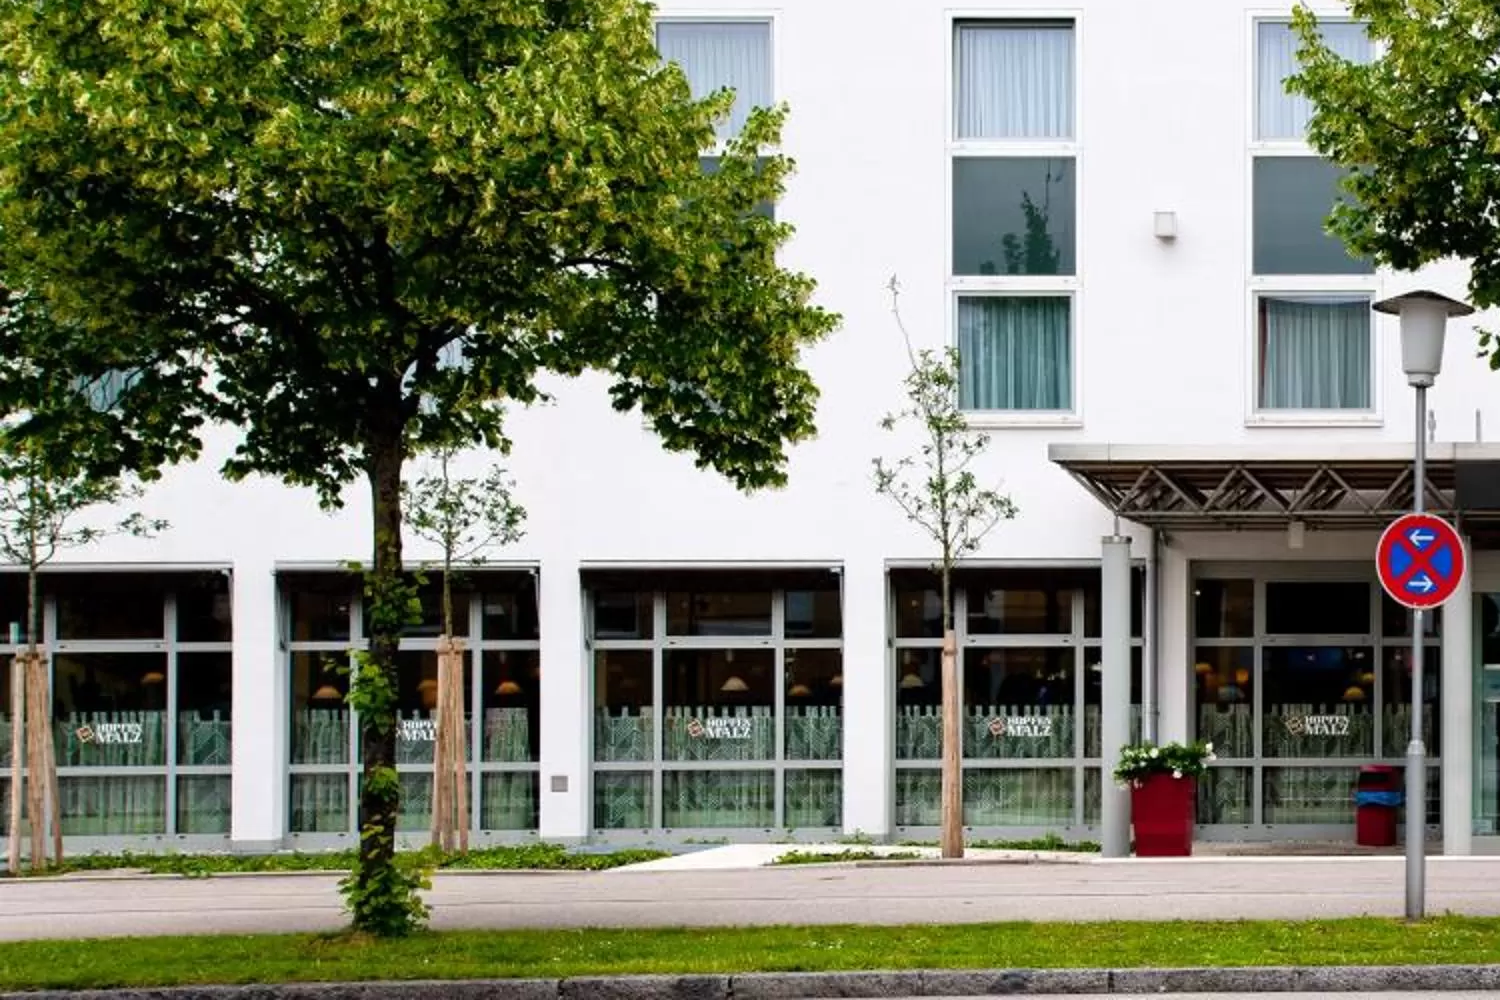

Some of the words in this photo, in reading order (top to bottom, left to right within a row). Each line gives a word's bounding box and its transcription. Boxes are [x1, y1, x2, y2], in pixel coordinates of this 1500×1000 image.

[402, 729, 438, 741] MAL
[705, 727, 751, 739] MALZ
[1006, 724, 1052, 737] MALZ
[1304, 723, 1349, 735] MALZ
[96, 731, 142, 743] MALZ
